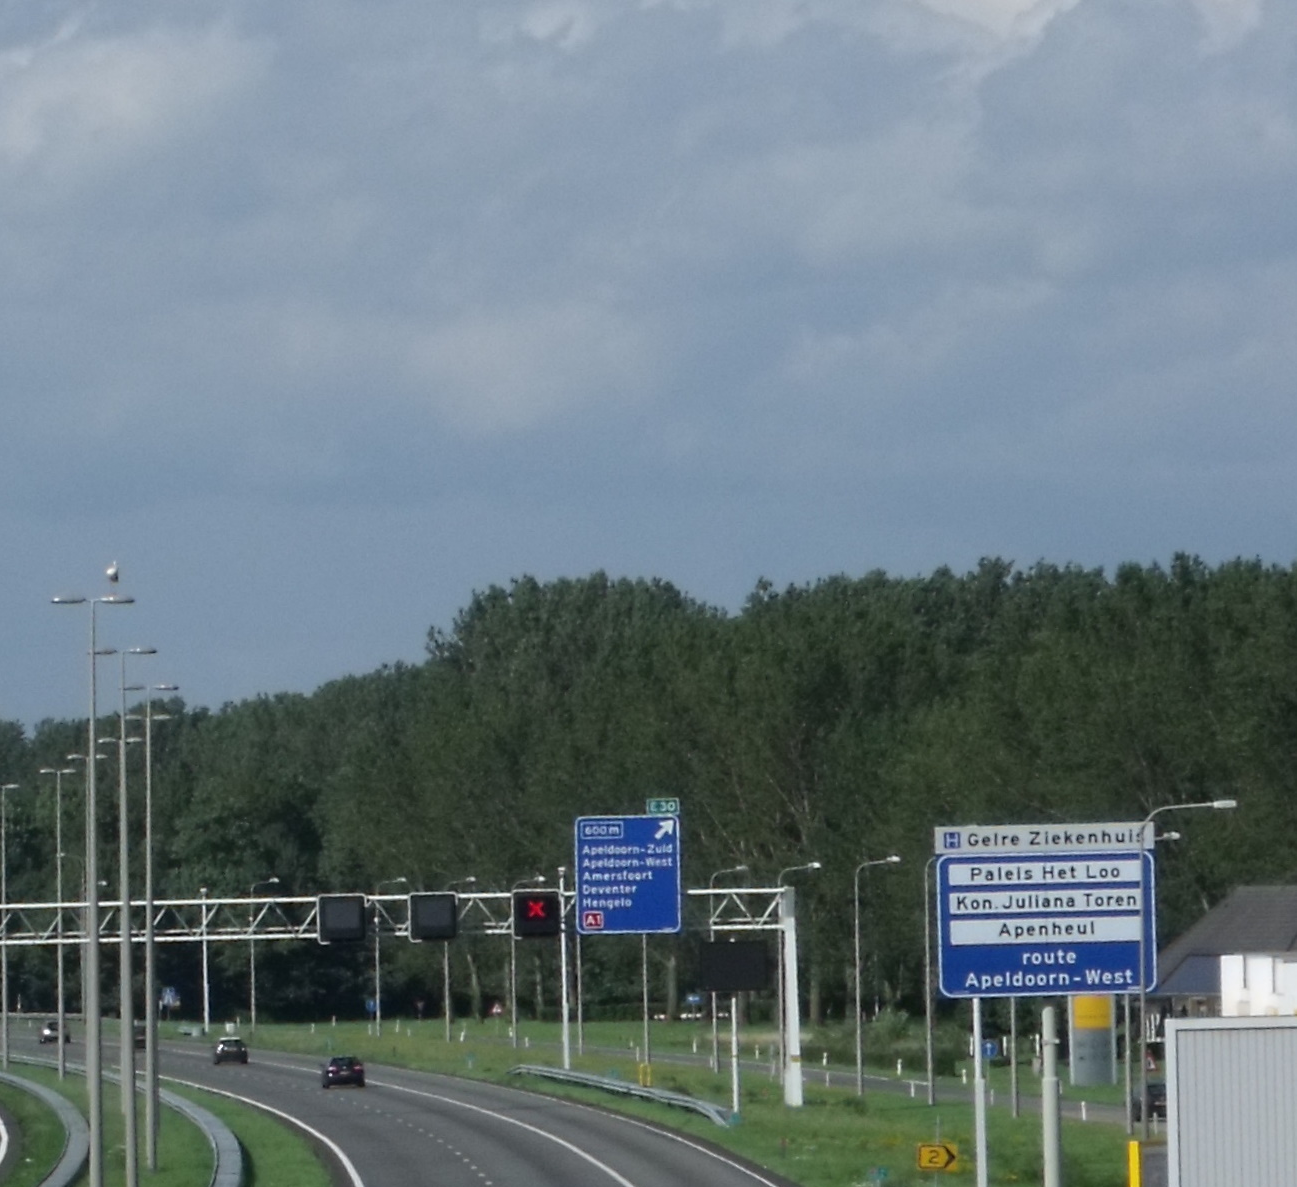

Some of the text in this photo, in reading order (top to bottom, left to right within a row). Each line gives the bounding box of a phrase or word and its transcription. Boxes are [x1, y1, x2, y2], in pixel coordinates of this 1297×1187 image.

[968, 833, 1020, 847] Gelre
[582, 870, 653, 881] Amersfoort
[970, 865, 1121, 881] Paleis Het Loo
[582, 884, 637, 894] Deventer
[582, 897, 633, 910] Hengelo
[1083, 893, 1137, 907] Toren
[585, 915, 602, 925] A1
[998, 921, 1095, 939] Apenheul
[1022, 950, 1077, 965] route
[965, 969, 1133, 990] Apeldoorn-West
[928, 1149, 939, 1164] 2
